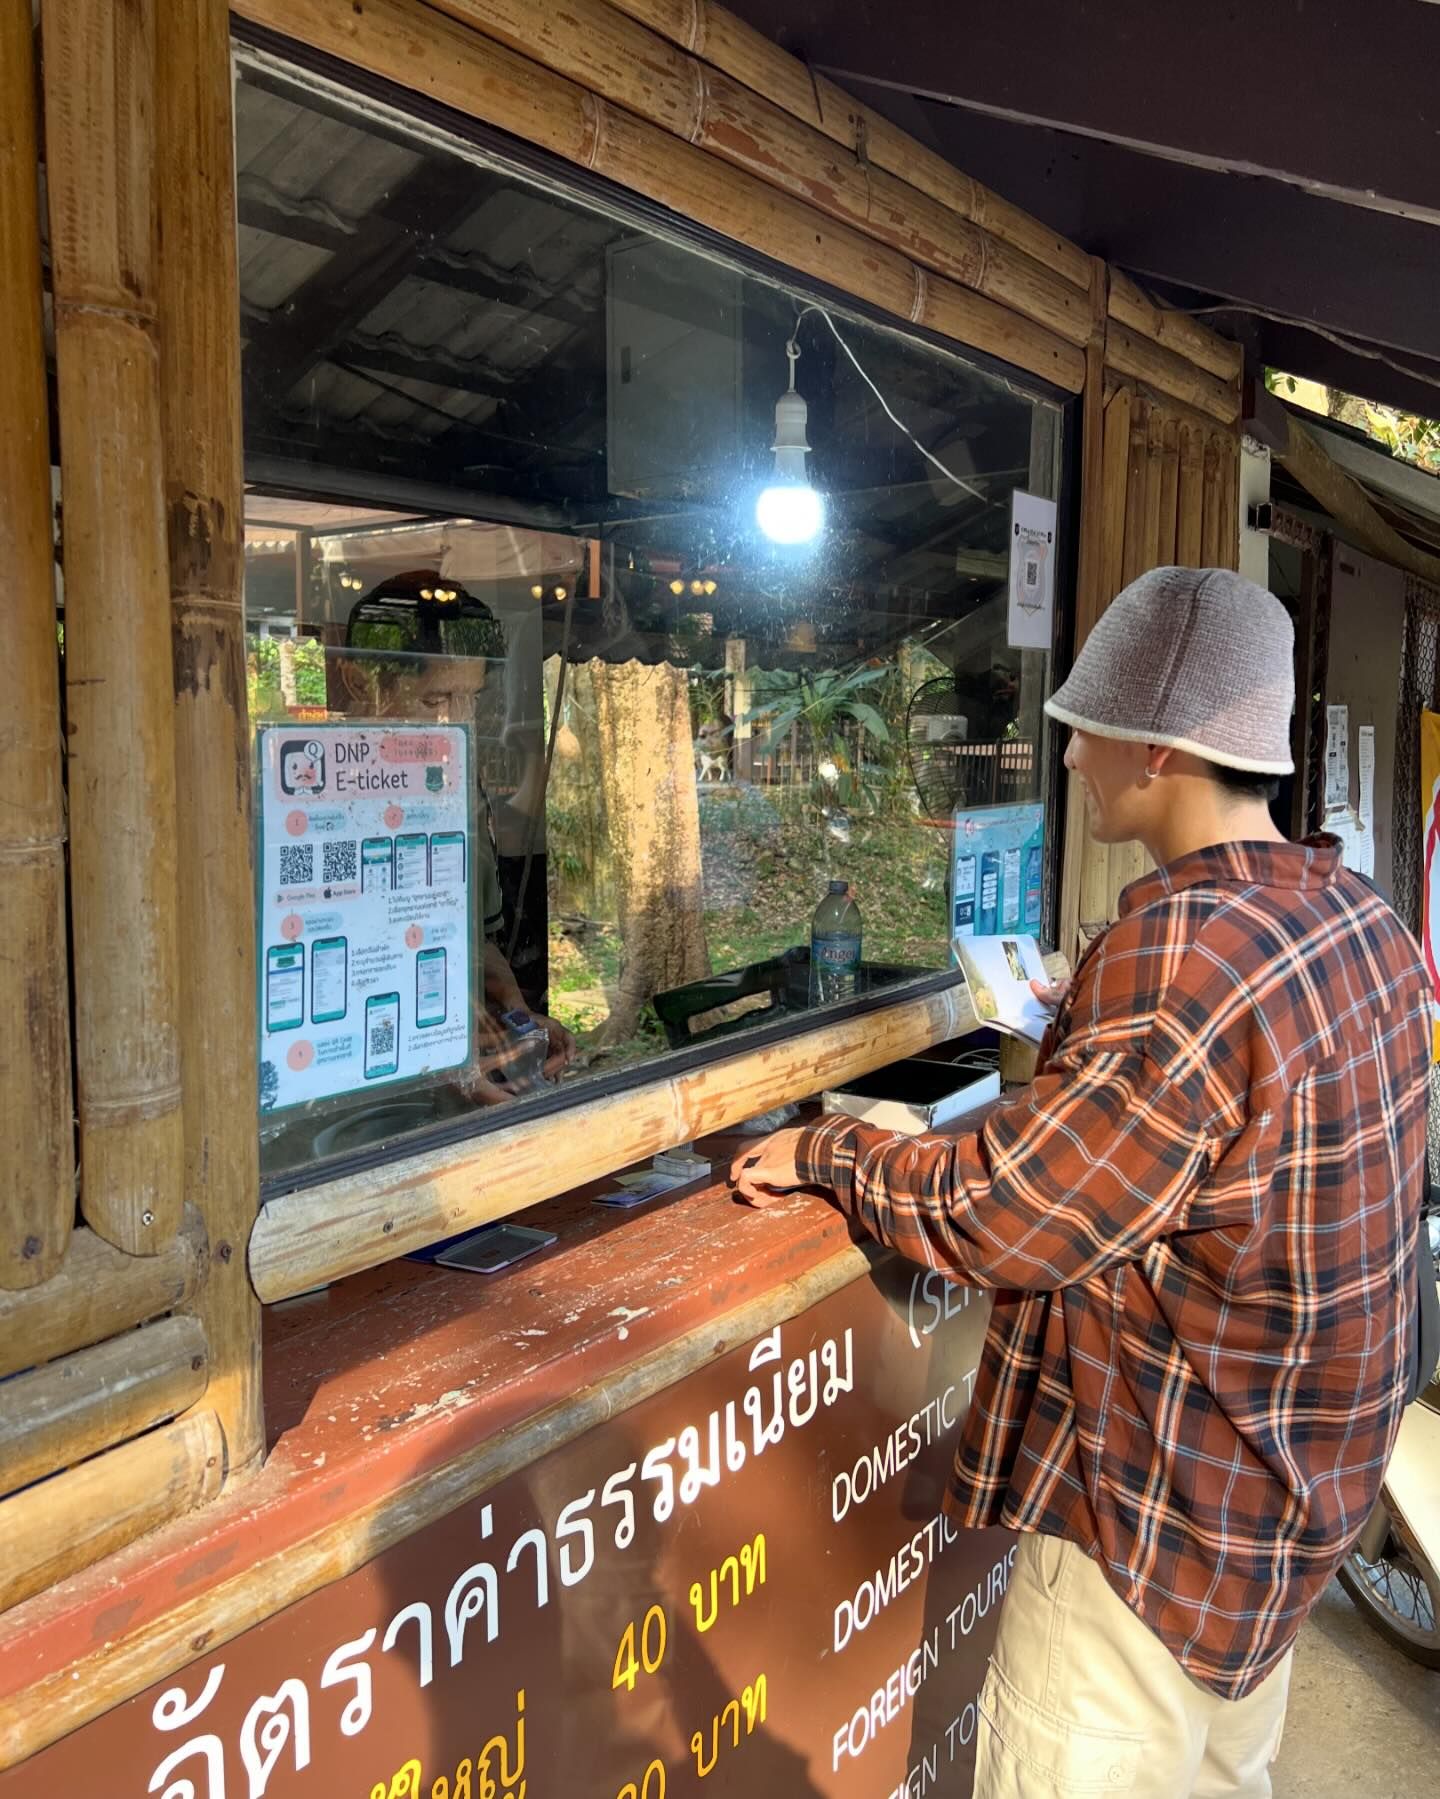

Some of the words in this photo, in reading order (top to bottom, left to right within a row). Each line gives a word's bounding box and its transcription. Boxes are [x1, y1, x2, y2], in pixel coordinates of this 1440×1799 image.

[335, 742, 370, 764] DNP
[336, 769, 409, 791] E-ticket
[832, 1386, 956, 1522] DOMESTIC
[612, 1604, 667, 1692] 40
[689, 1533, 767, 1642] บาท
[834, 1512, 958, 1653] DOMESTIC
[691, 1673, 767, 1777] บาท
[833, 1626, 938, 1773] FOREIGN
